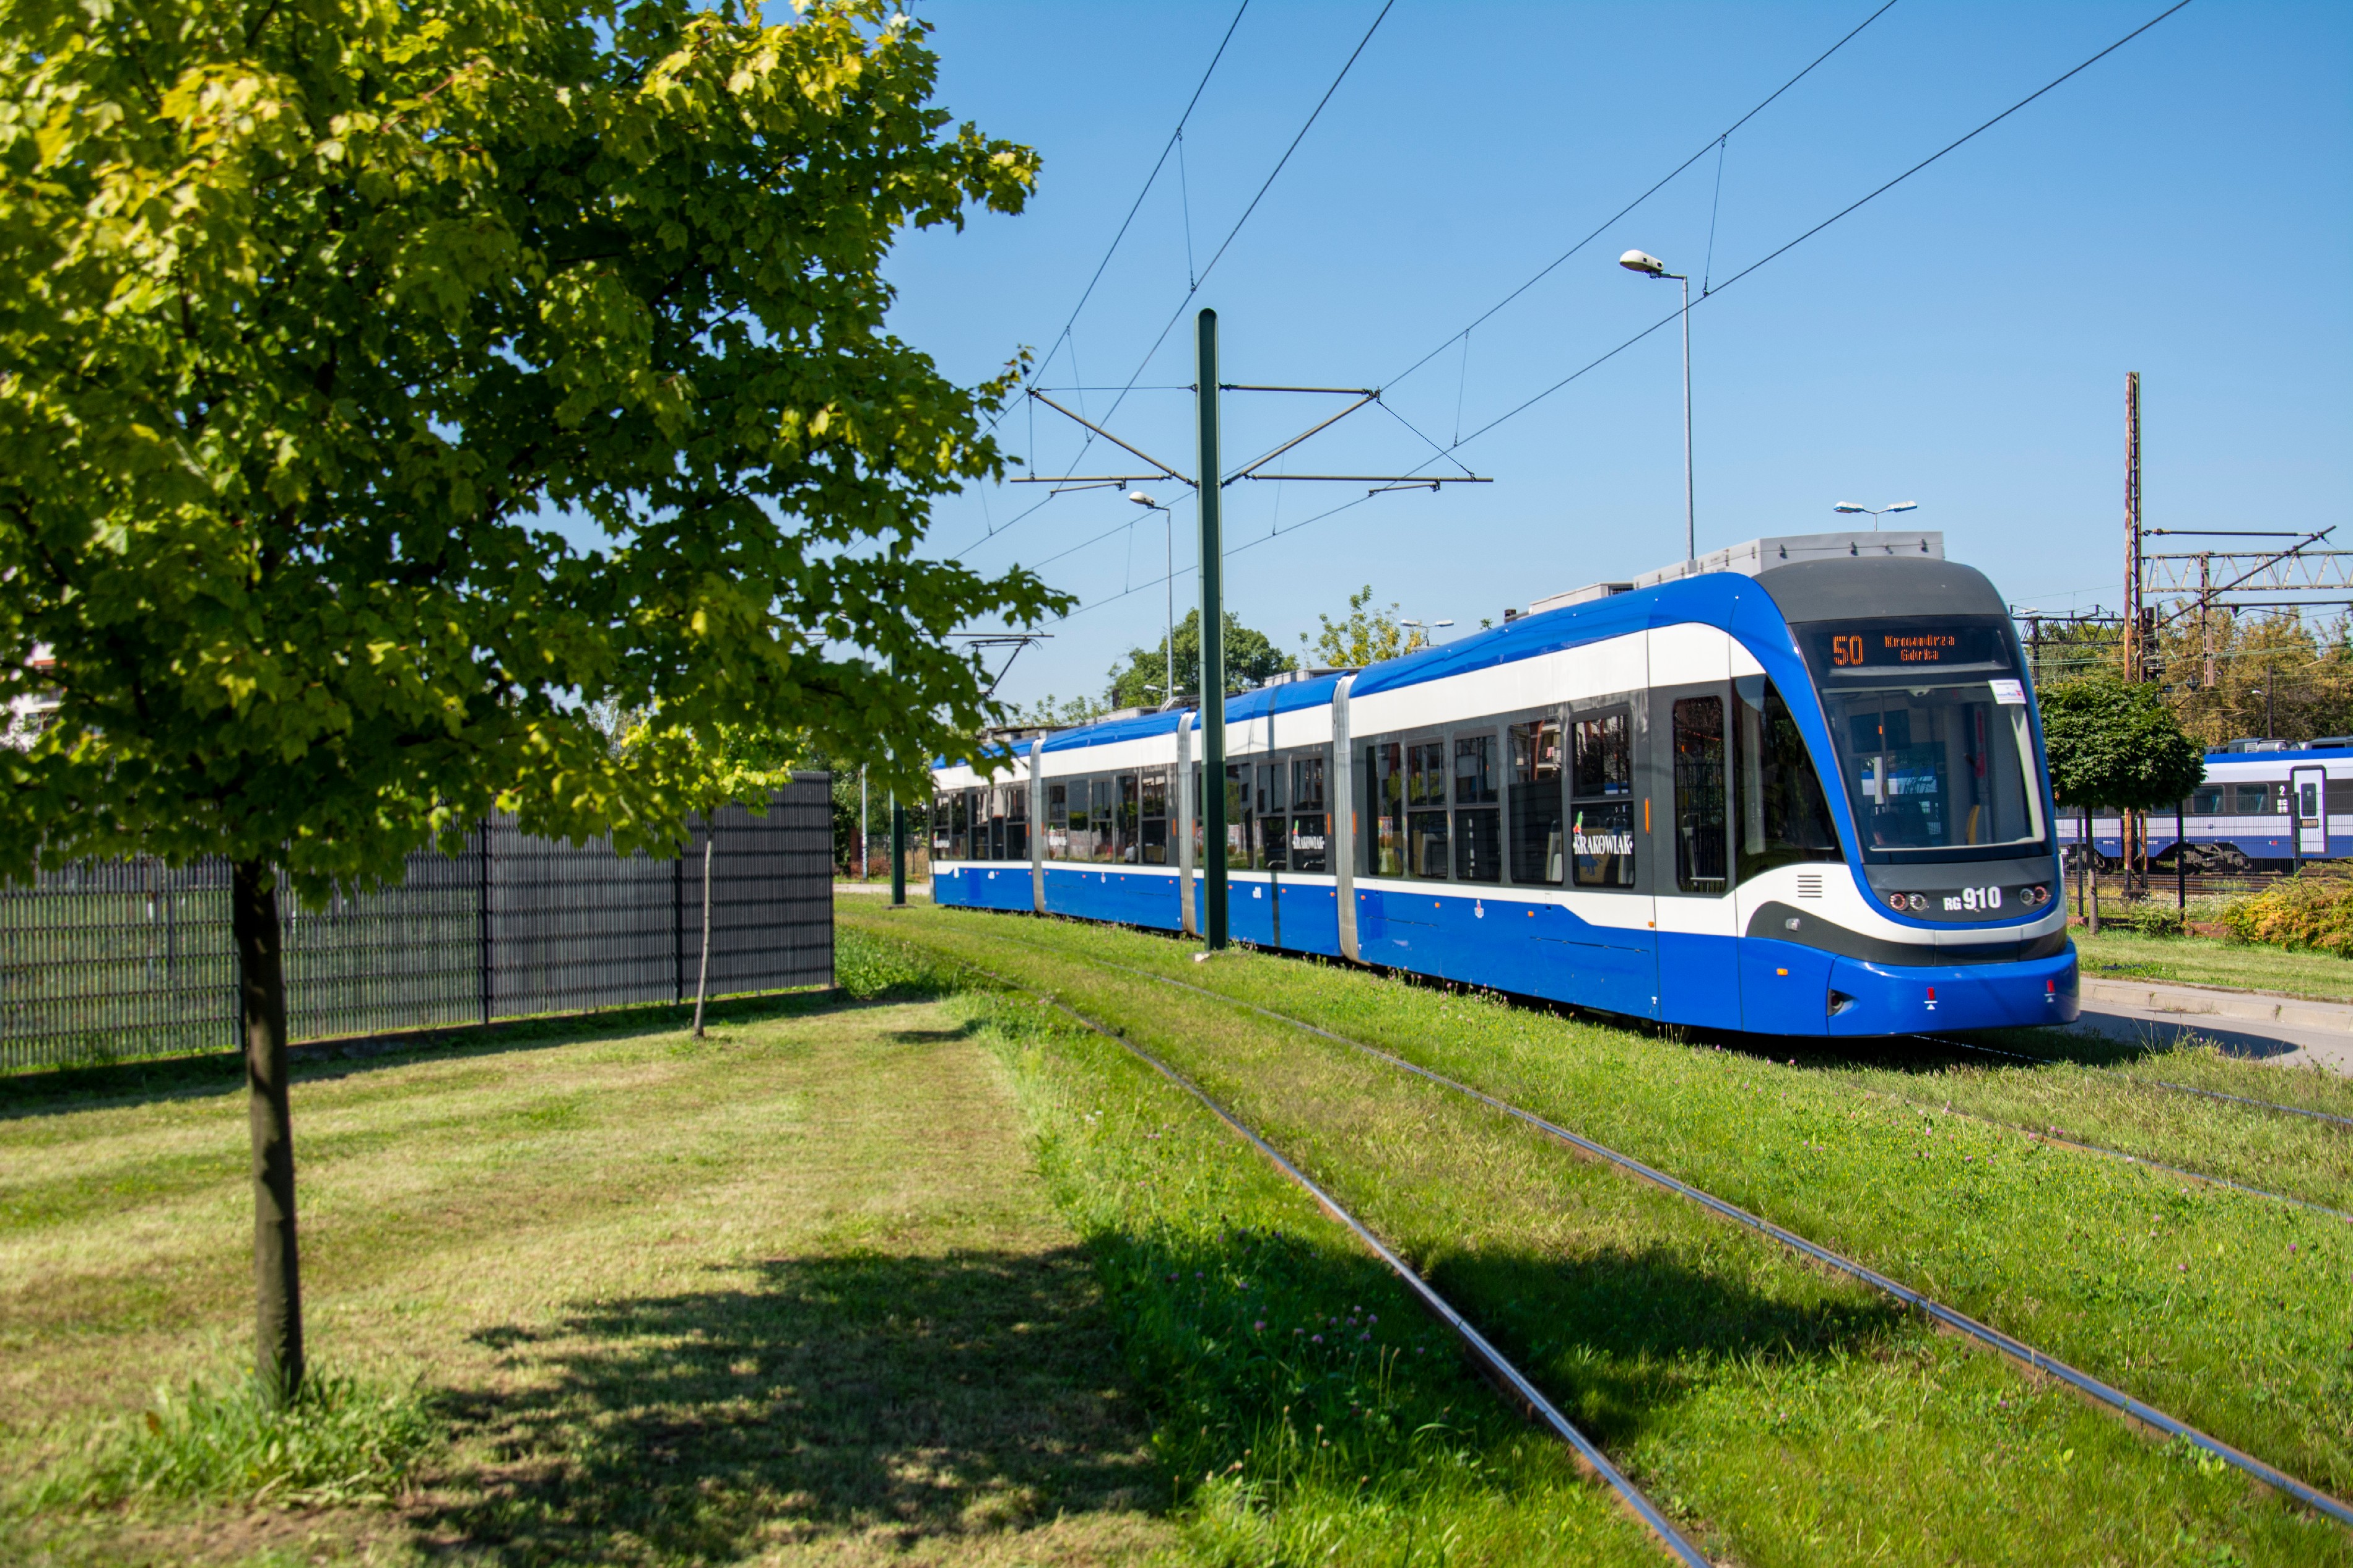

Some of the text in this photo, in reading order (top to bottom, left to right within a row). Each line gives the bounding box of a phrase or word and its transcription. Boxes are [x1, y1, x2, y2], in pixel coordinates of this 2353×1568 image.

[1833, 636, 1863, 665] 50
[2279, 785, 2286, 796] 2
[1573, 834, 1632, 855] KRAKOWIAK
[1943, 886, 2002, 911] RG 910
